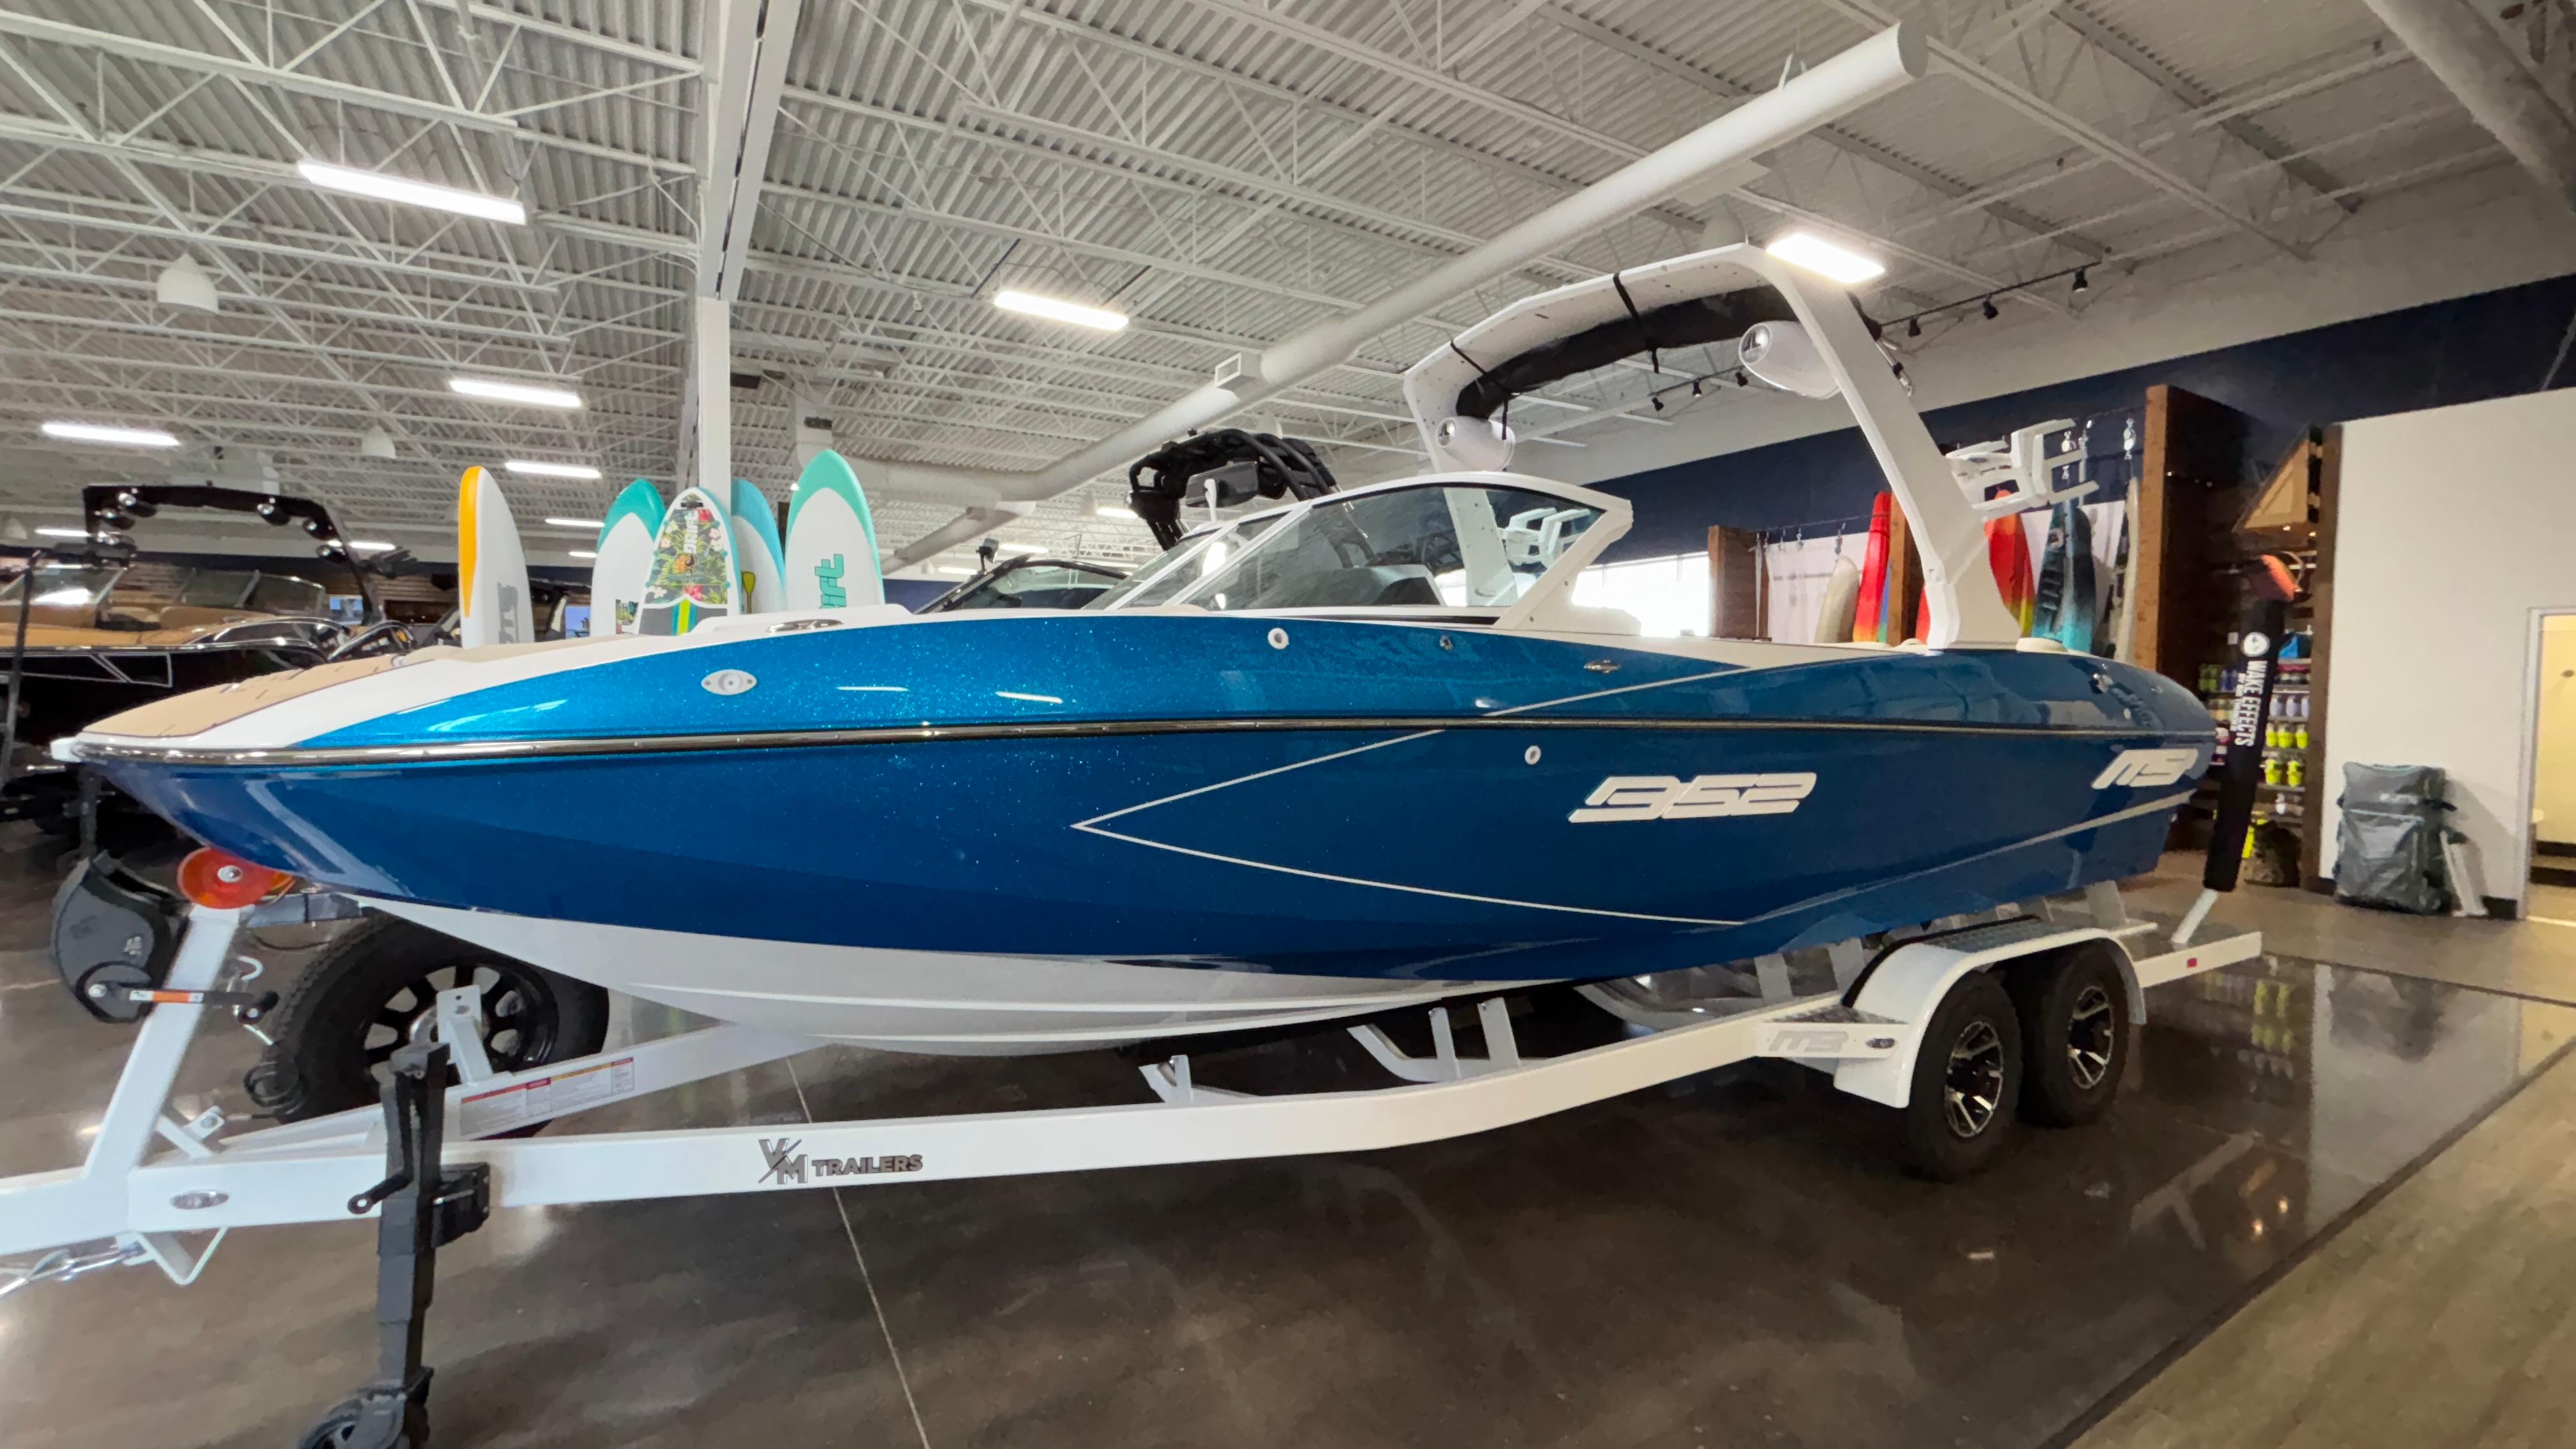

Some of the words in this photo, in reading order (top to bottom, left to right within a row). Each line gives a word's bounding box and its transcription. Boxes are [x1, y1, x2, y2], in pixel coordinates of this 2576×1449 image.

[2243, 660, 2268, 695] WAKE
[2234, 695, 2262, 747] EFFECTS
[811, 1154, 924, 1177] TRAILERS
